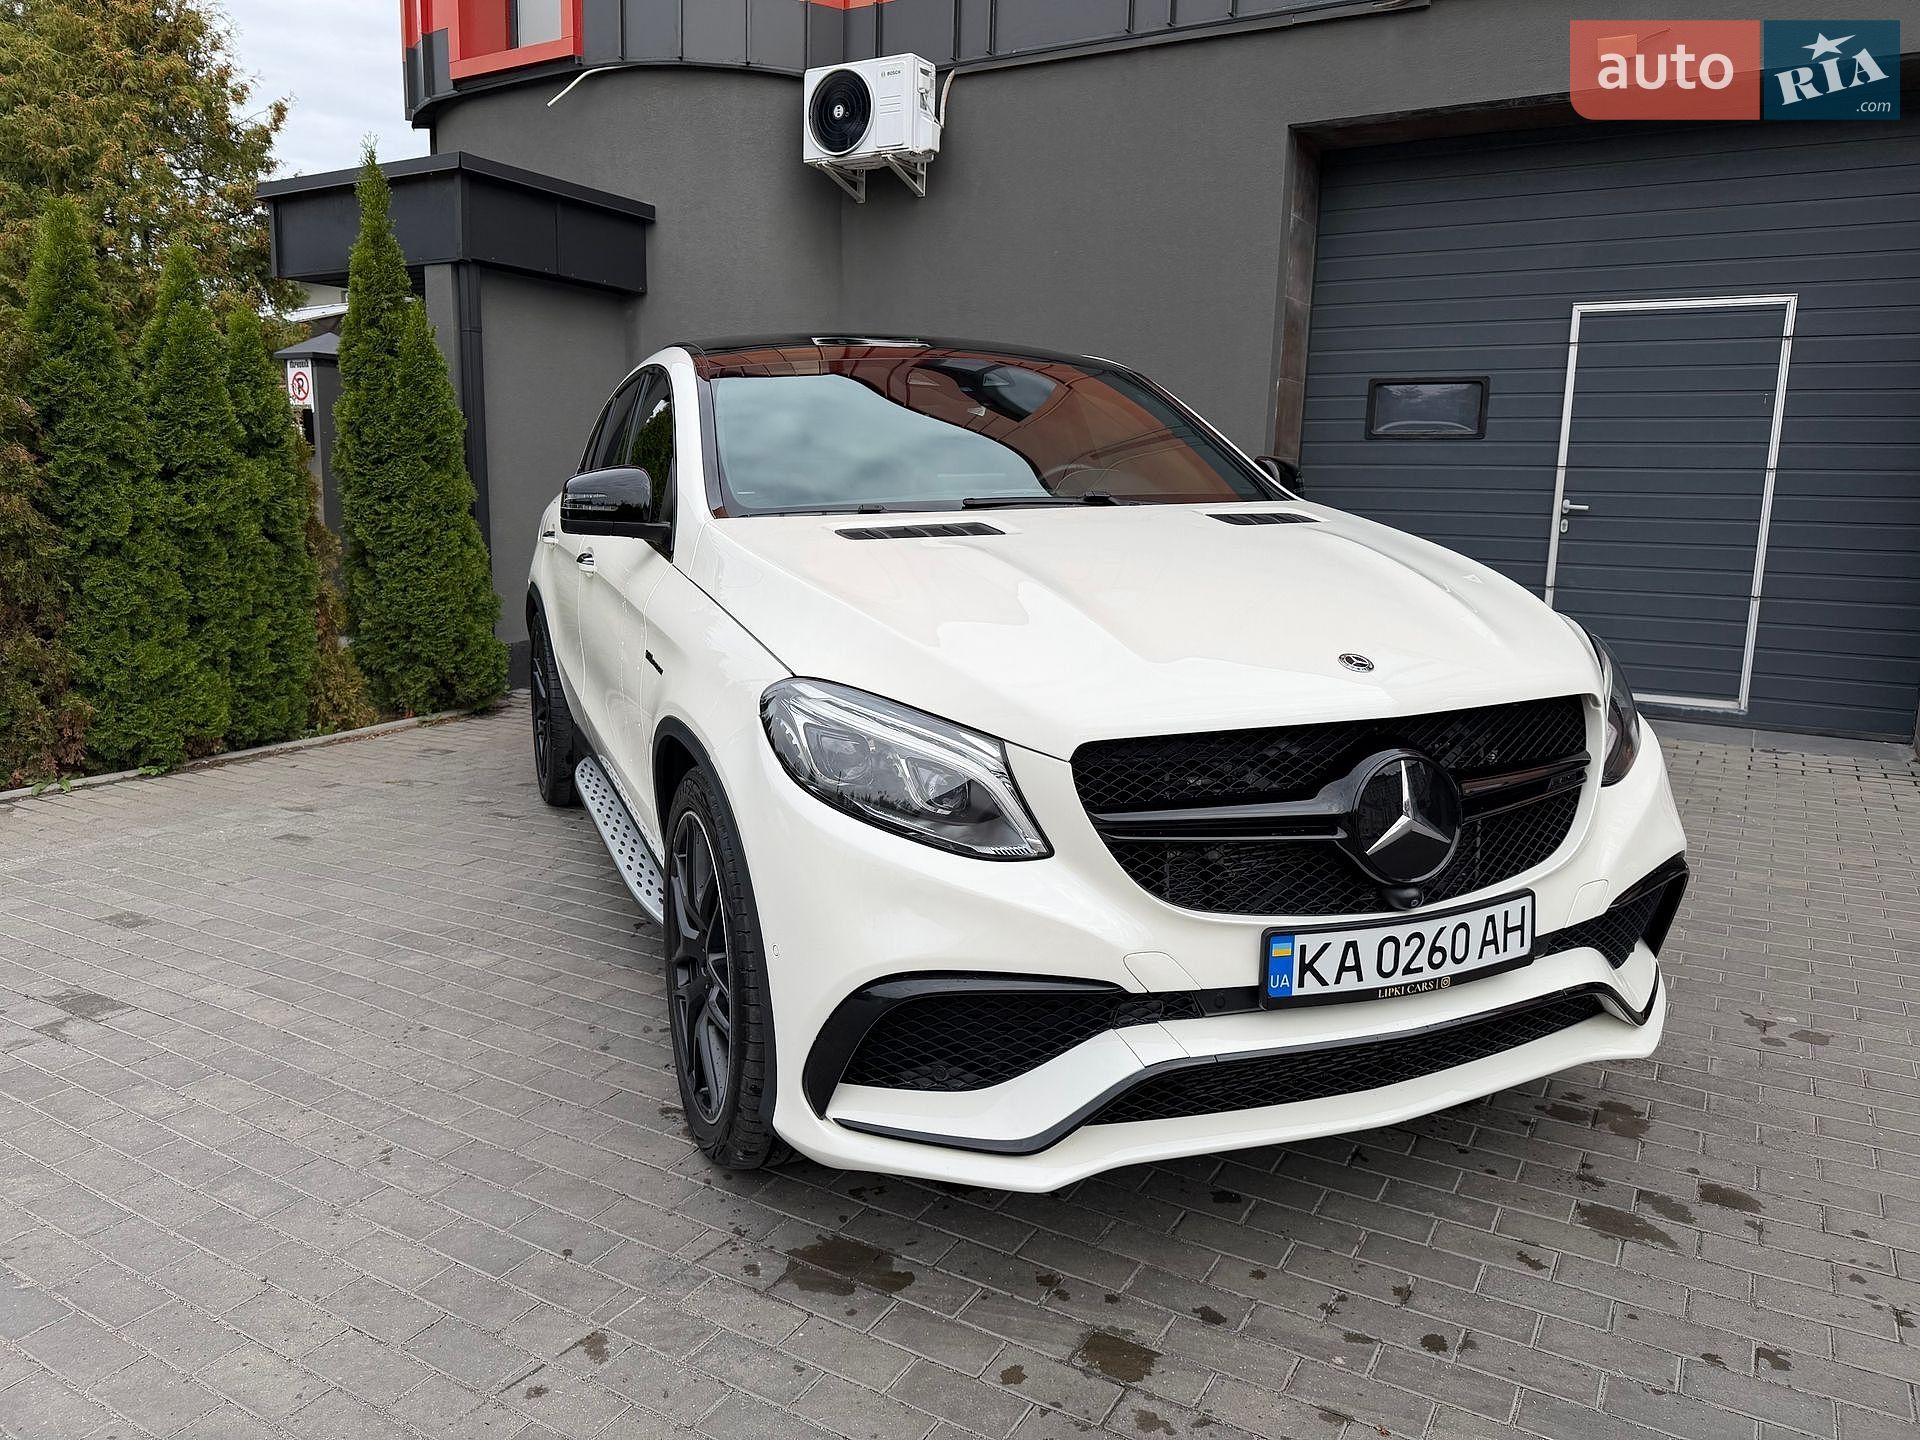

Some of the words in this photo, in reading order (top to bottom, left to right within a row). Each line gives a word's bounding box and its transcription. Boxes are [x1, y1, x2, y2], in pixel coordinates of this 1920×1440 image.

[1297, 940, 1364, 989] KA
[1376, 921, 1471, 979] 0260
[1477, 905, 1526, 960] AH
[1270, 974, 1290, 989] UA
[1378, 985, 1405, 999] LIPKI
[1406, 980, 1434, 994] CARS
